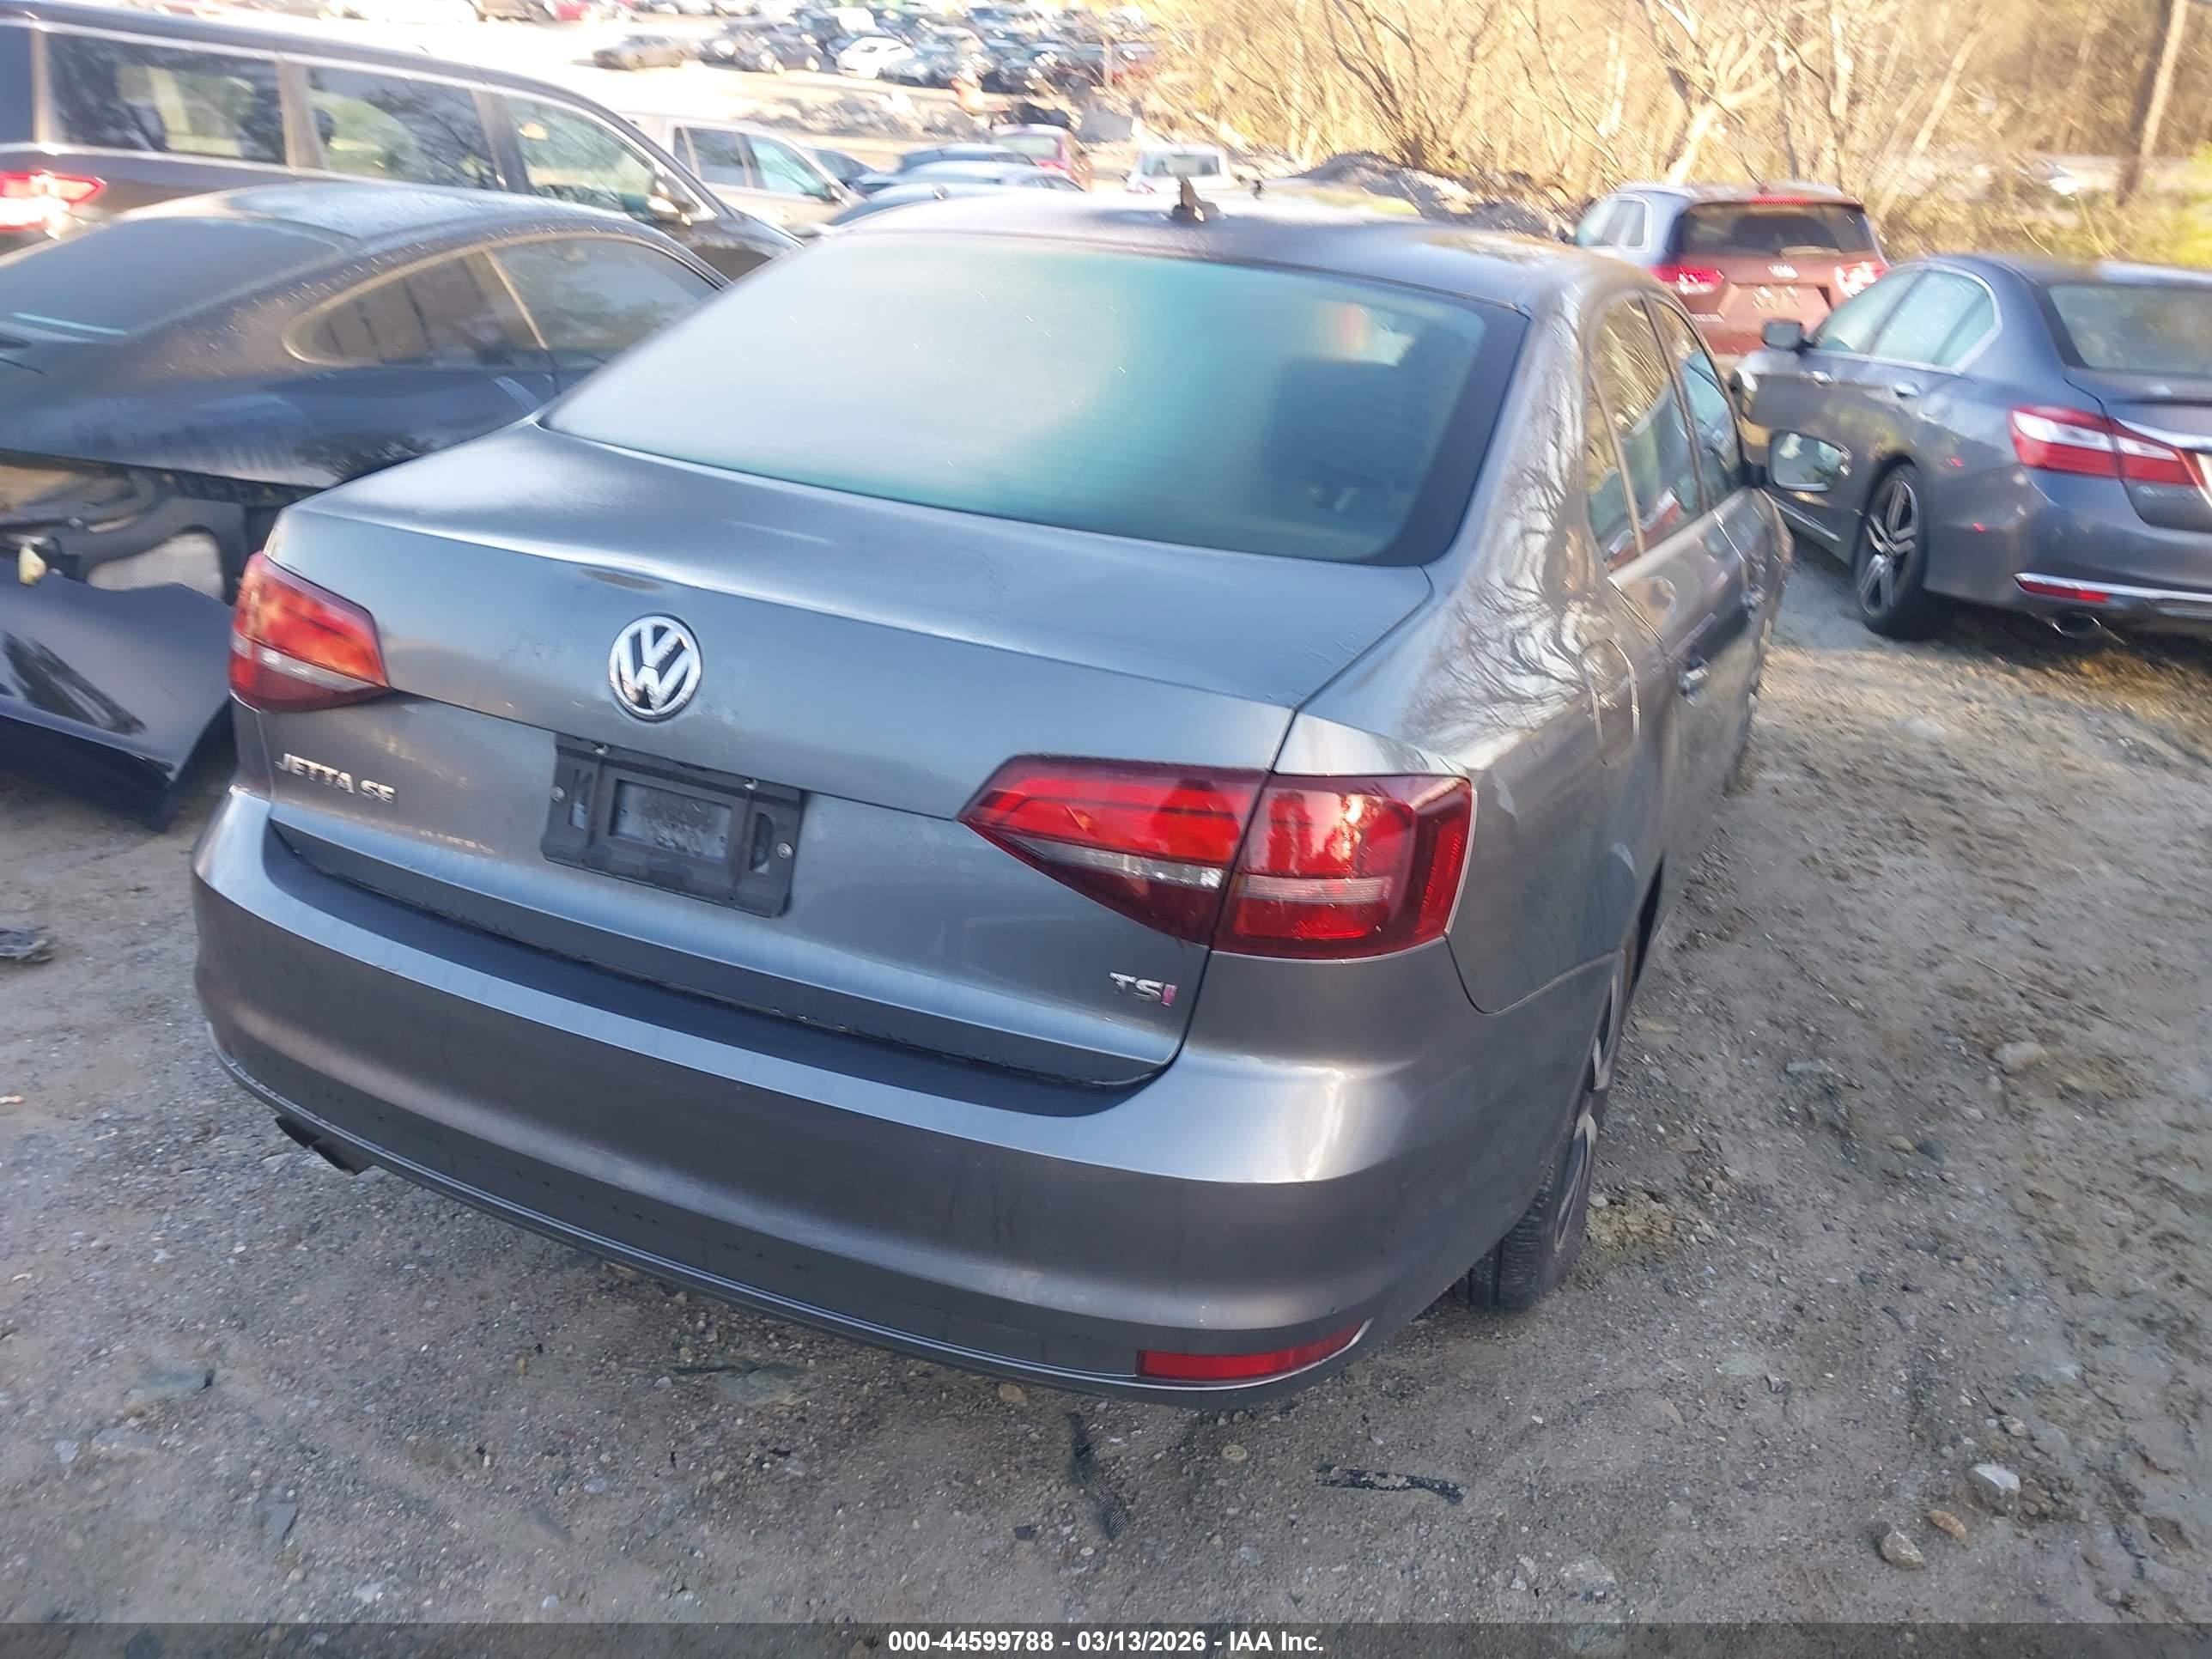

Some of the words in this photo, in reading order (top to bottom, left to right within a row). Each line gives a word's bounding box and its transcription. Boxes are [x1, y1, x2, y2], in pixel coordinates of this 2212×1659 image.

[609, 615, 702, 716] VW
[274, 752, 356, 794] JETTA
[360, 780, 396, 804] SE
